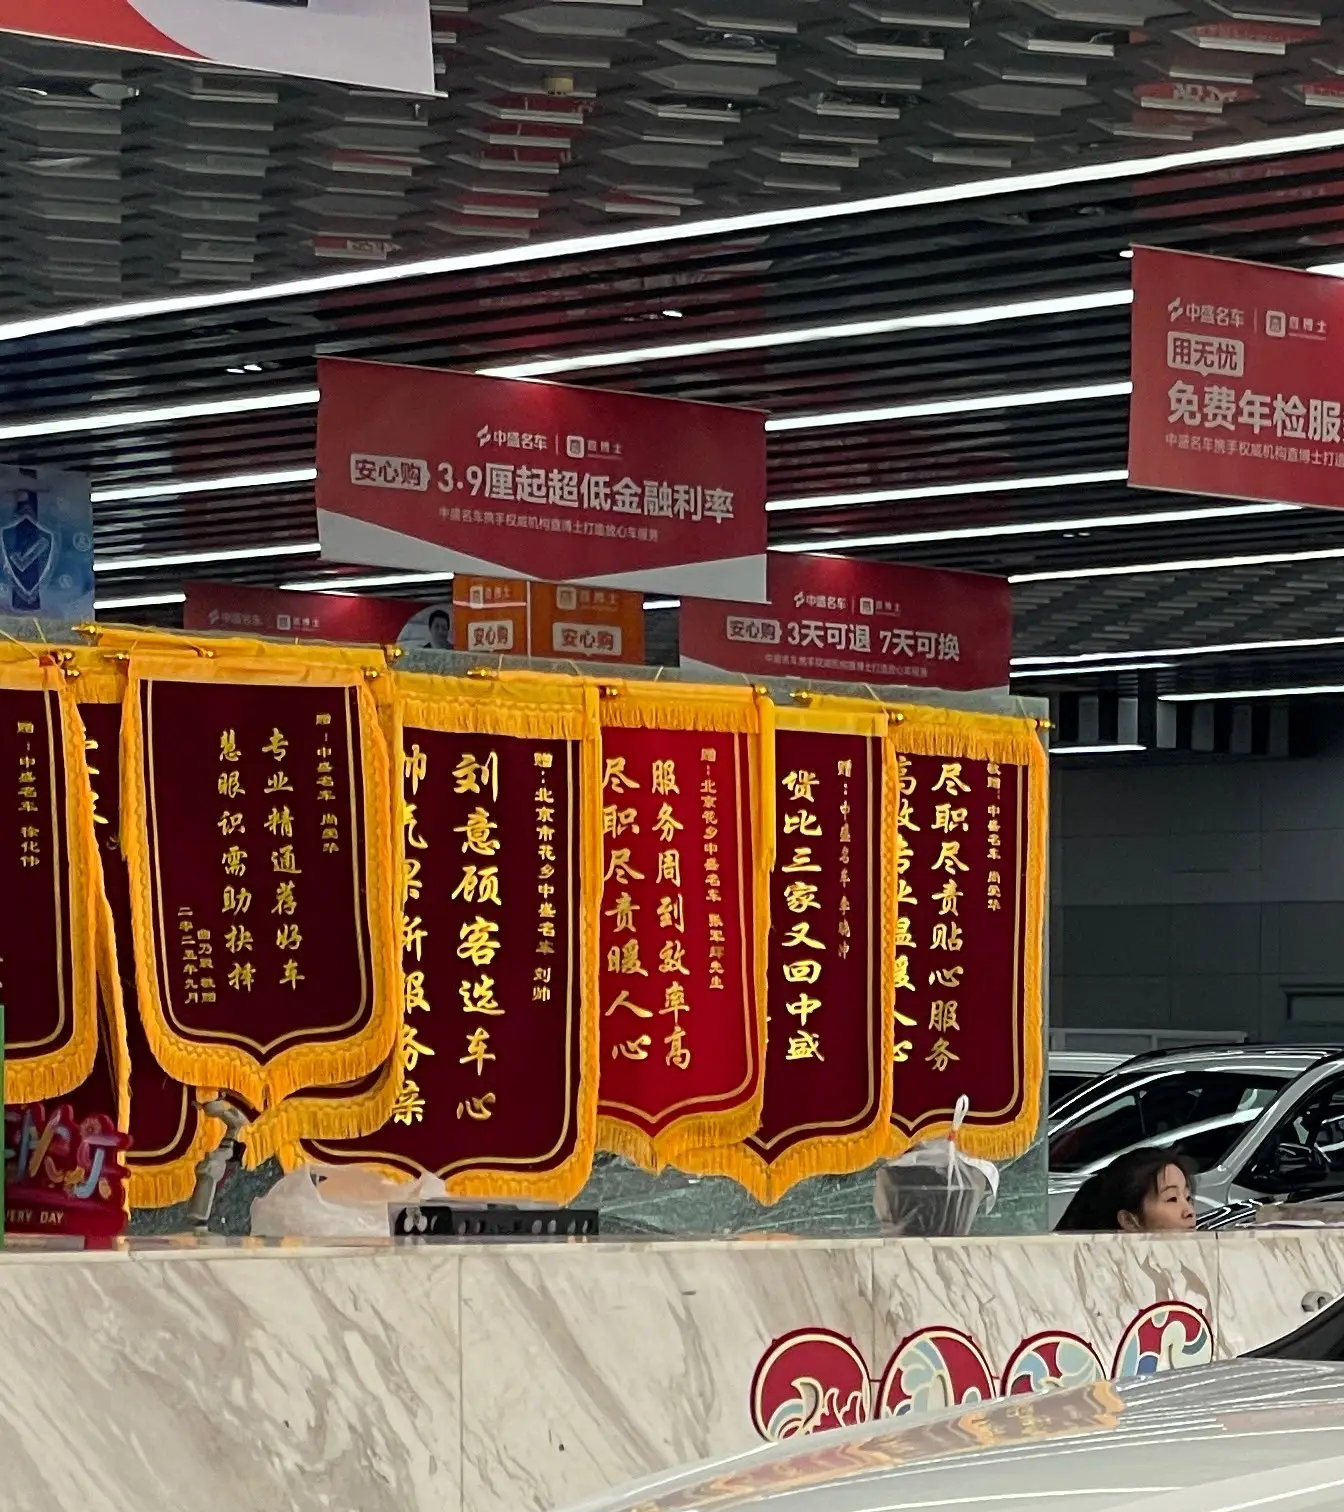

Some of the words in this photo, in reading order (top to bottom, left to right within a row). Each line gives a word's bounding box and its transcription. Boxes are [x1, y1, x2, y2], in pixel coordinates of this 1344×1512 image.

[1186, 304, 1244, 327] 中盛名车
[1172, 338, 1238, 371] 用无忧
[493, 430, 547, 450] 中盛名车
[355, 457, 421, 487] 安心购
[437, 462, 734, 524] 3.9厘起超低金融利率
[560, 627, 615, 650] 安心购
[730, 618, 776, 639] 安心购
[788, 620, 870, 652] 3天可退
[879, 630, 960, 661] 7天可换
[261, 728, 306, 991] 专业精通荐好车
[603, 758, 653, 1062] 尽职尽责暖人心
[651, 760, 691, 1070] 服务周到效率高
[781, 770, 826, 1062] 货比三家又回中盛
[926, 762, 971, 1072] 尽职尽责贴心服务
[40, 1211, 64, 1224] DAY
